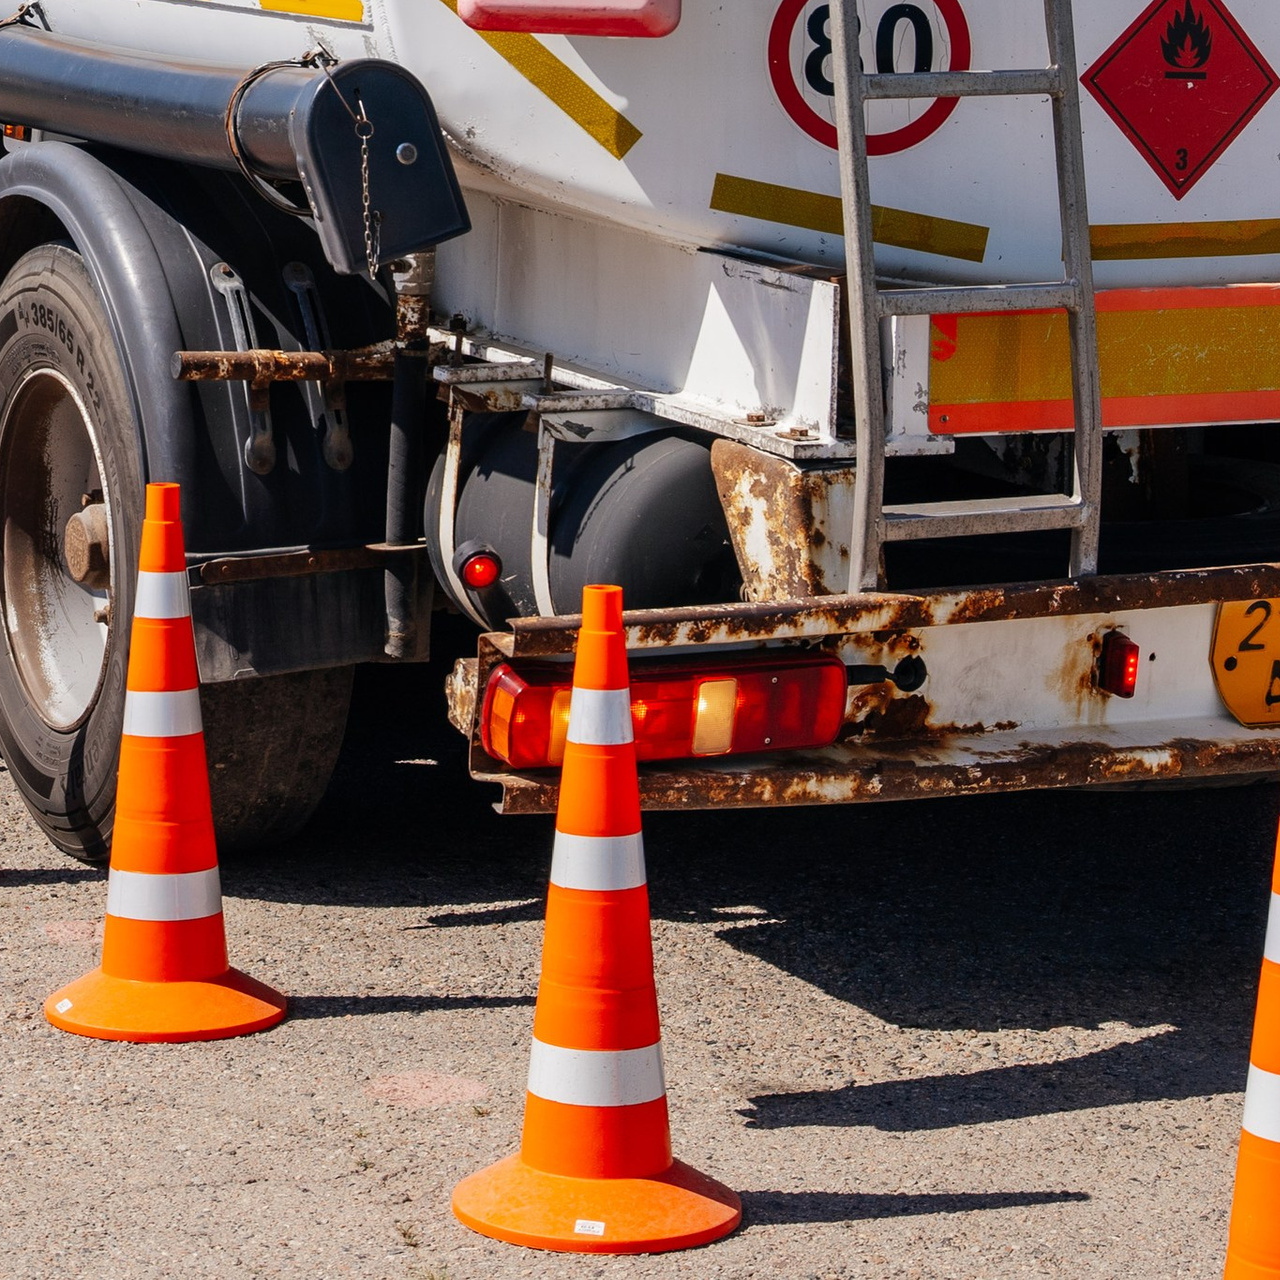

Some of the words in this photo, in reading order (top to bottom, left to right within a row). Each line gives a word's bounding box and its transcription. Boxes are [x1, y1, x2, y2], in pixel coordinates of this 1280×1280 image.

[1175, 148, 1188, 171] 3
[31, 302, 74, 354] 385/65
[76, 345, 85, 375] R
